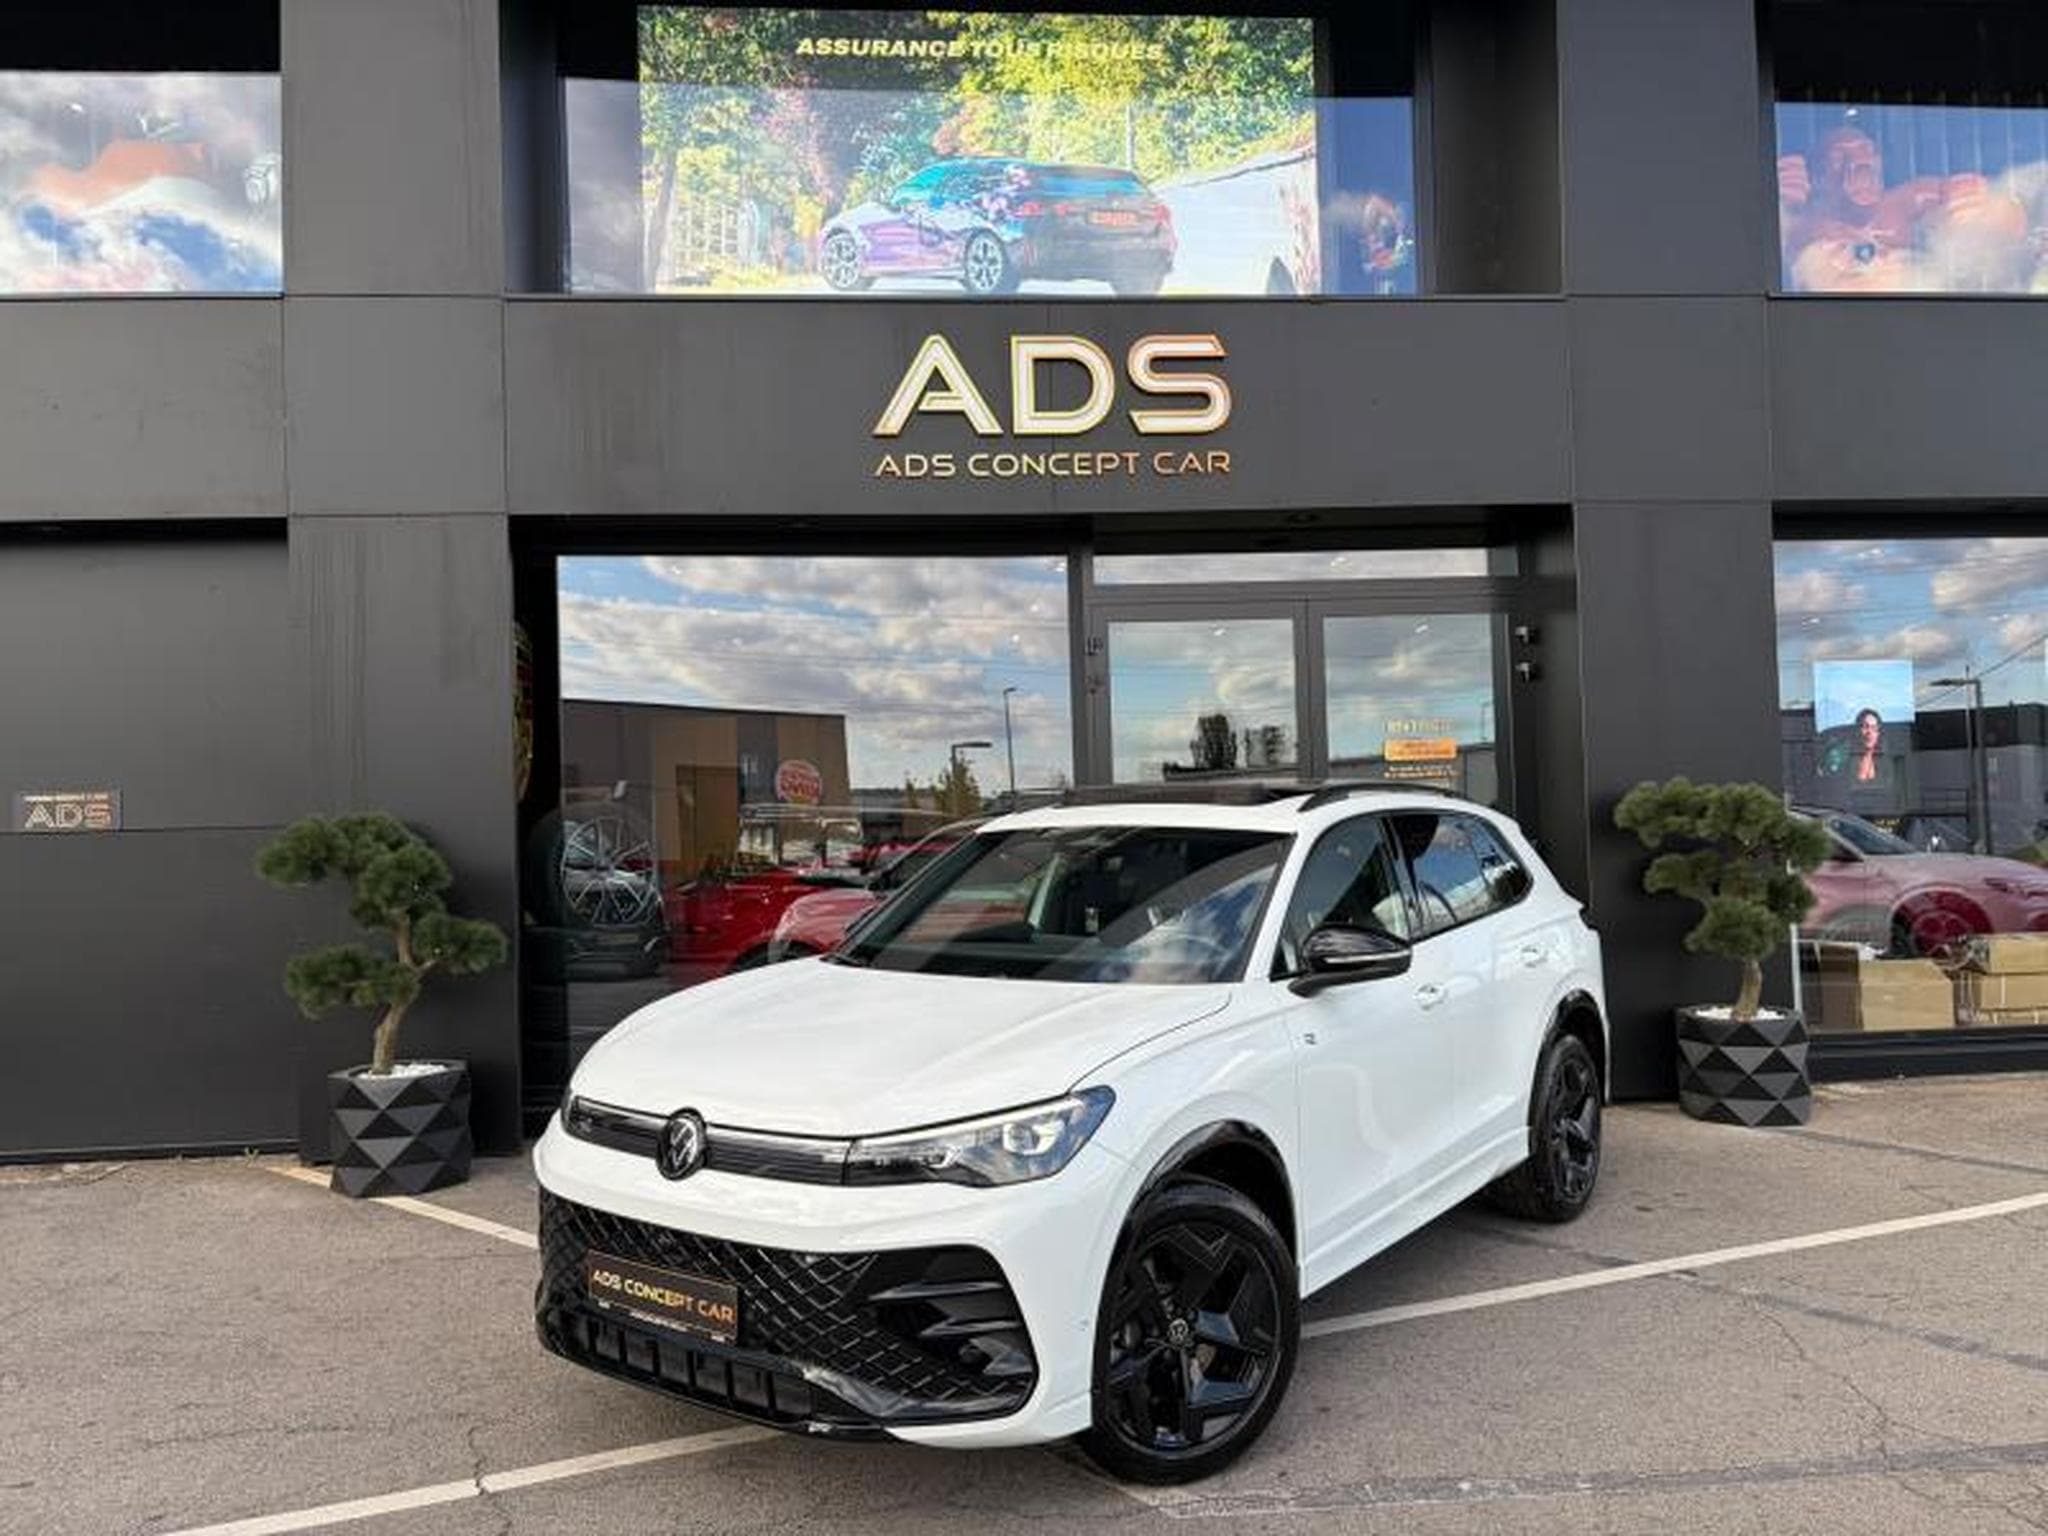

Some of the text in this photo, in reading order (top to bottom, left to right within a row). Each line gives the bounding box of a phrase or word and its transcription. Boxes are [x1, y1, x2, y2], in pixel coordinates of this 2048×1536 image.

[796, 37, 965, 58] ASSURANCE
[970, 39, 1041, 59] TOUS
[872, 333, 1233, 436] ADS
[874, 451, 1232, 478] ADS CONCEPT CAR
[24, 803, 112, 828] ADS
[593, 1269, 622, 1291] ADS
[624, 1279, 694, 1311] CONCEPT
[697, 1299, 734, 1322] CAR
